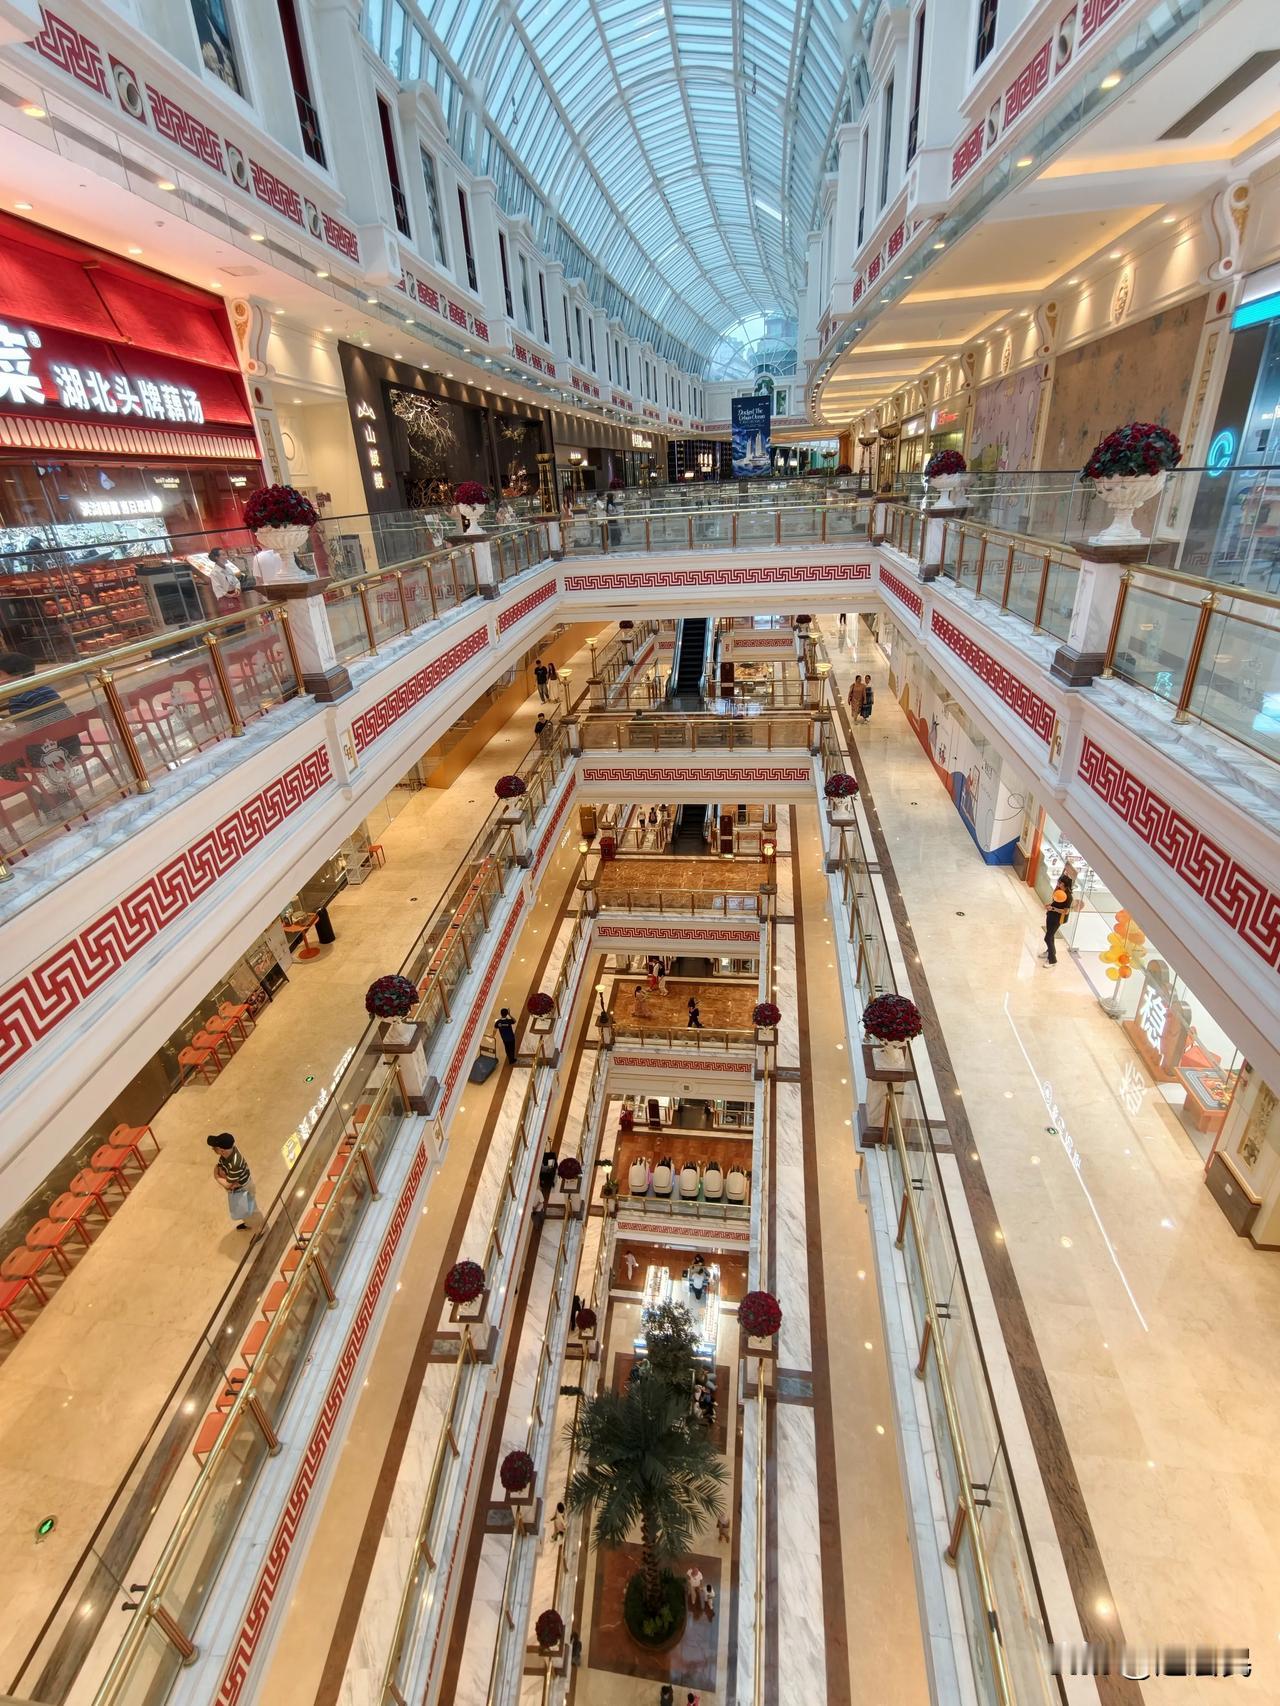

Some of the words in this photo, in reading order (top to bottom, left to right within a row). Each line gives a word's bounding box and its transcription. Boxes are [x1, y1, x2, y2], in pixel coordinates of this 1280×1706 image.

[53, 365, 205, 425] 湖北头牌藕汤
